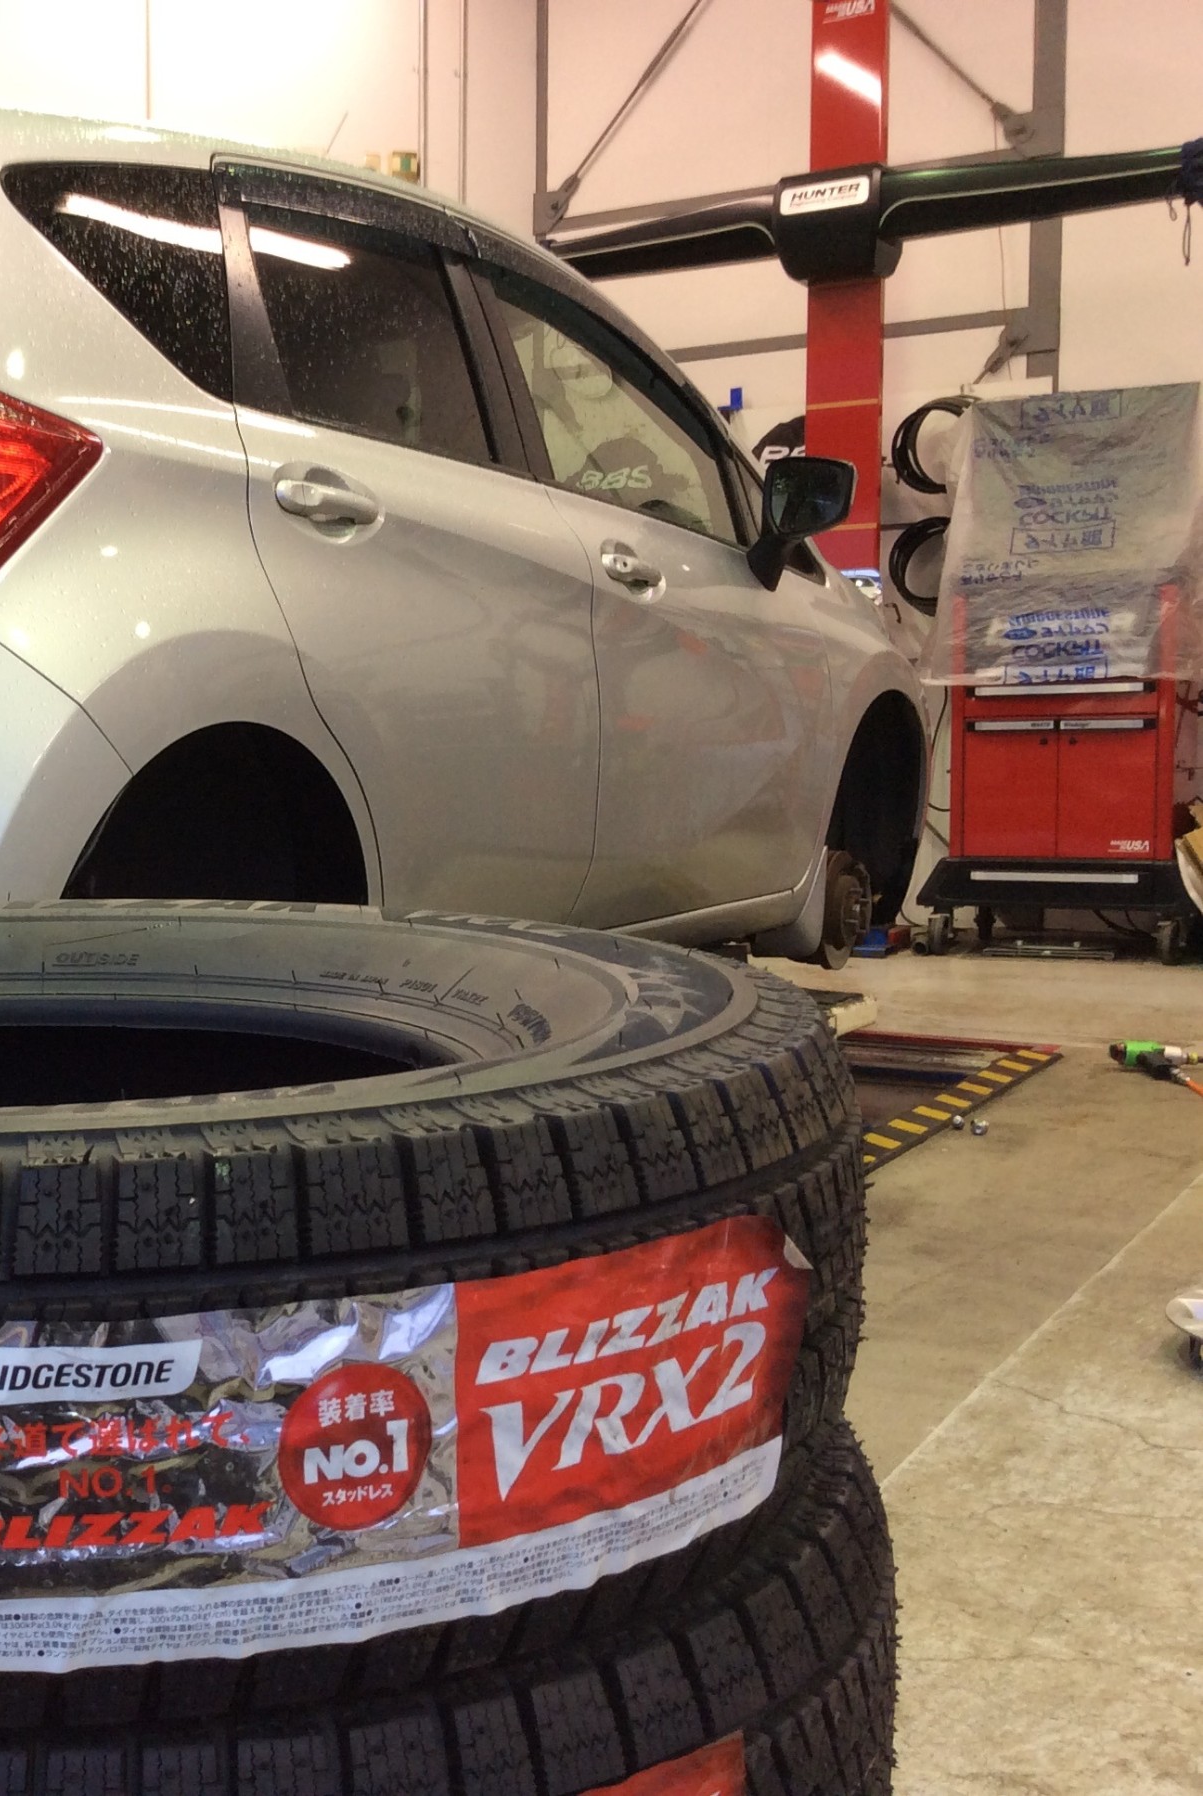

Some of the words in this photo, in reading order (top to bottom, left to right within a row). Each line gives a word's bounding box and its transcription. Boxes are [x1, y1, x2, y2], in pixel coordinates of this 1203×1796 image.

[791, 182, 860, 200] HUNTER
[55, 951, 140, 966] OUTSIDE
[475, 1267, 779, 1385] BLIZZAK
[317, 1389, 395, 1428] 装着率
[479, 1321, 767, 1502] VRX2
[303, 1418, 410, 1485] NO.1
[322, 1483, 395, 1507] スタッドレス
